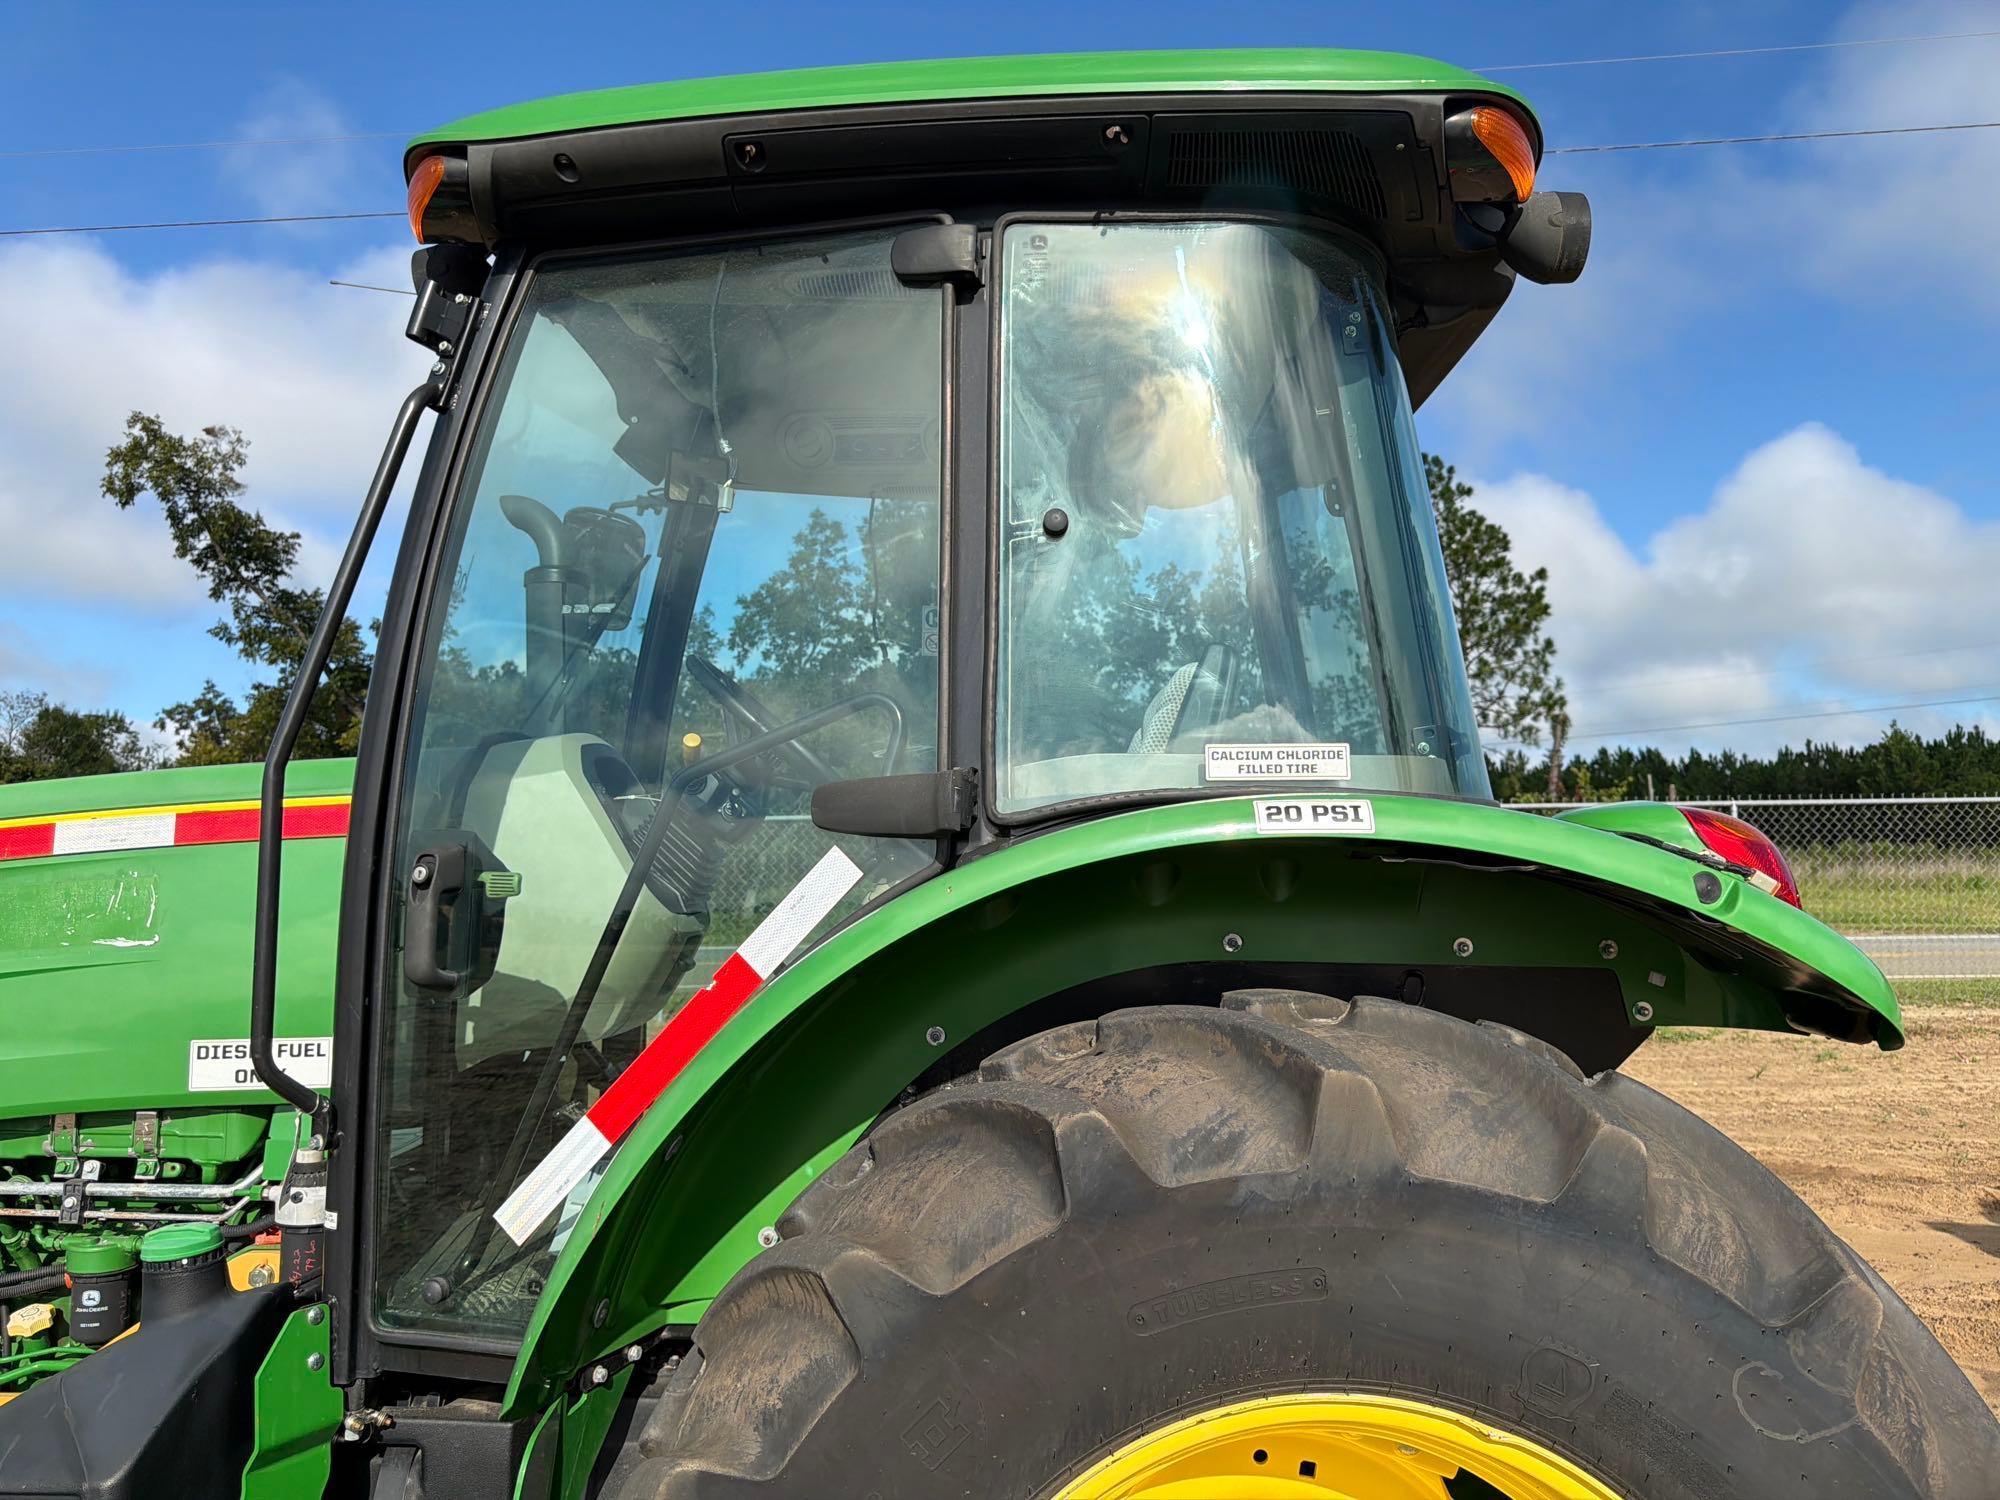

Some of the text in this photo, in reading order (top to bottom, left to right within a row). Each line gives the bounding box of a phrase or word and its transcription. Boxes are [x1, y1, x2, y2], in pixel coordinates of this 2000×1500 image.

[1211, 750, 1344, 761] CALCIUM CHLORIDE
[1238, 763, 1318, 774] FILLED TIRE
[1265, 805, 1363, 823] 20 PSI
[197, 1043, 326, 1060] DIES FUEL
[1152, 1276, 1305, 1323] TUBELESS
[88, 1305, 109, 1313] DEERE
